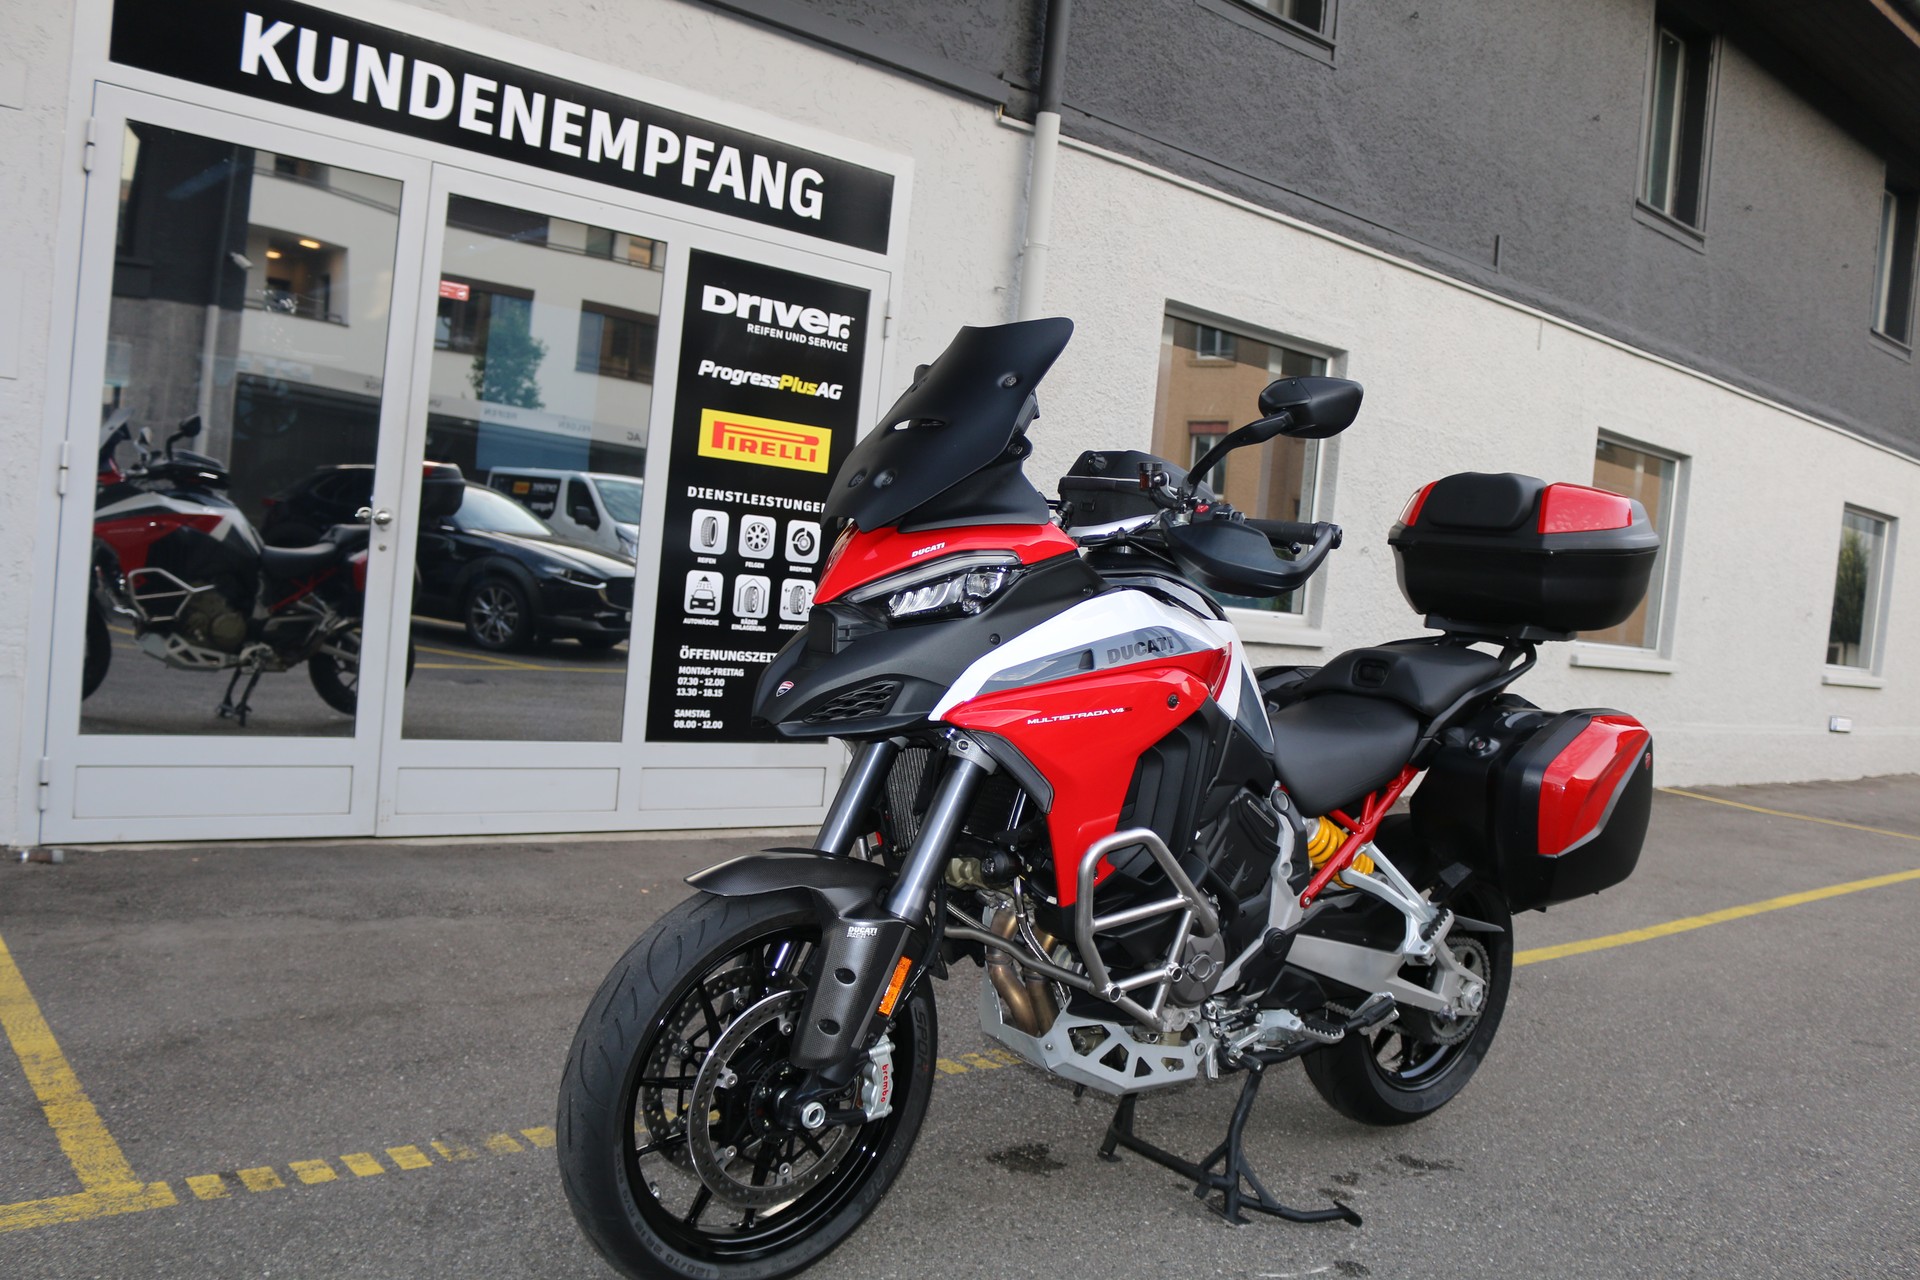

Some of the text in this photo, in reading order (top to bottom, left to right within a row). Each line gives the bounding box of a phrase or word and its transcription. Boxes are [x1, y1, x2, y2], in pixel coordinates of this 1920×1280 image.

[240, 13, 825, 221] KUNDENEMPFANG
[747, 323, 848, 352] REIFEN UND SERVICE
[711, 420, 819, 463] PIRELLI
[911, 542, 945, 558] DUCATI
[1107, 634, 1174, 665] DUCATI
[678, 666, 744, 677] MONTAG-FREITAG
[677, 677, 699, 686] 07.30
[704, 678, 725, 687] 12.00
[676, 688, 698, 697] 13.30
[674, 709, 710, 718] SAMSTAG
[1027, 709, 1109, 725] MULTISTRADA
[673, 720, 697, 729] 08.00
[702, 720, 723, 729] 12.00
[848, 926, 878, 934] DUCATI
[881, 1064, 889, 1103] brembo
